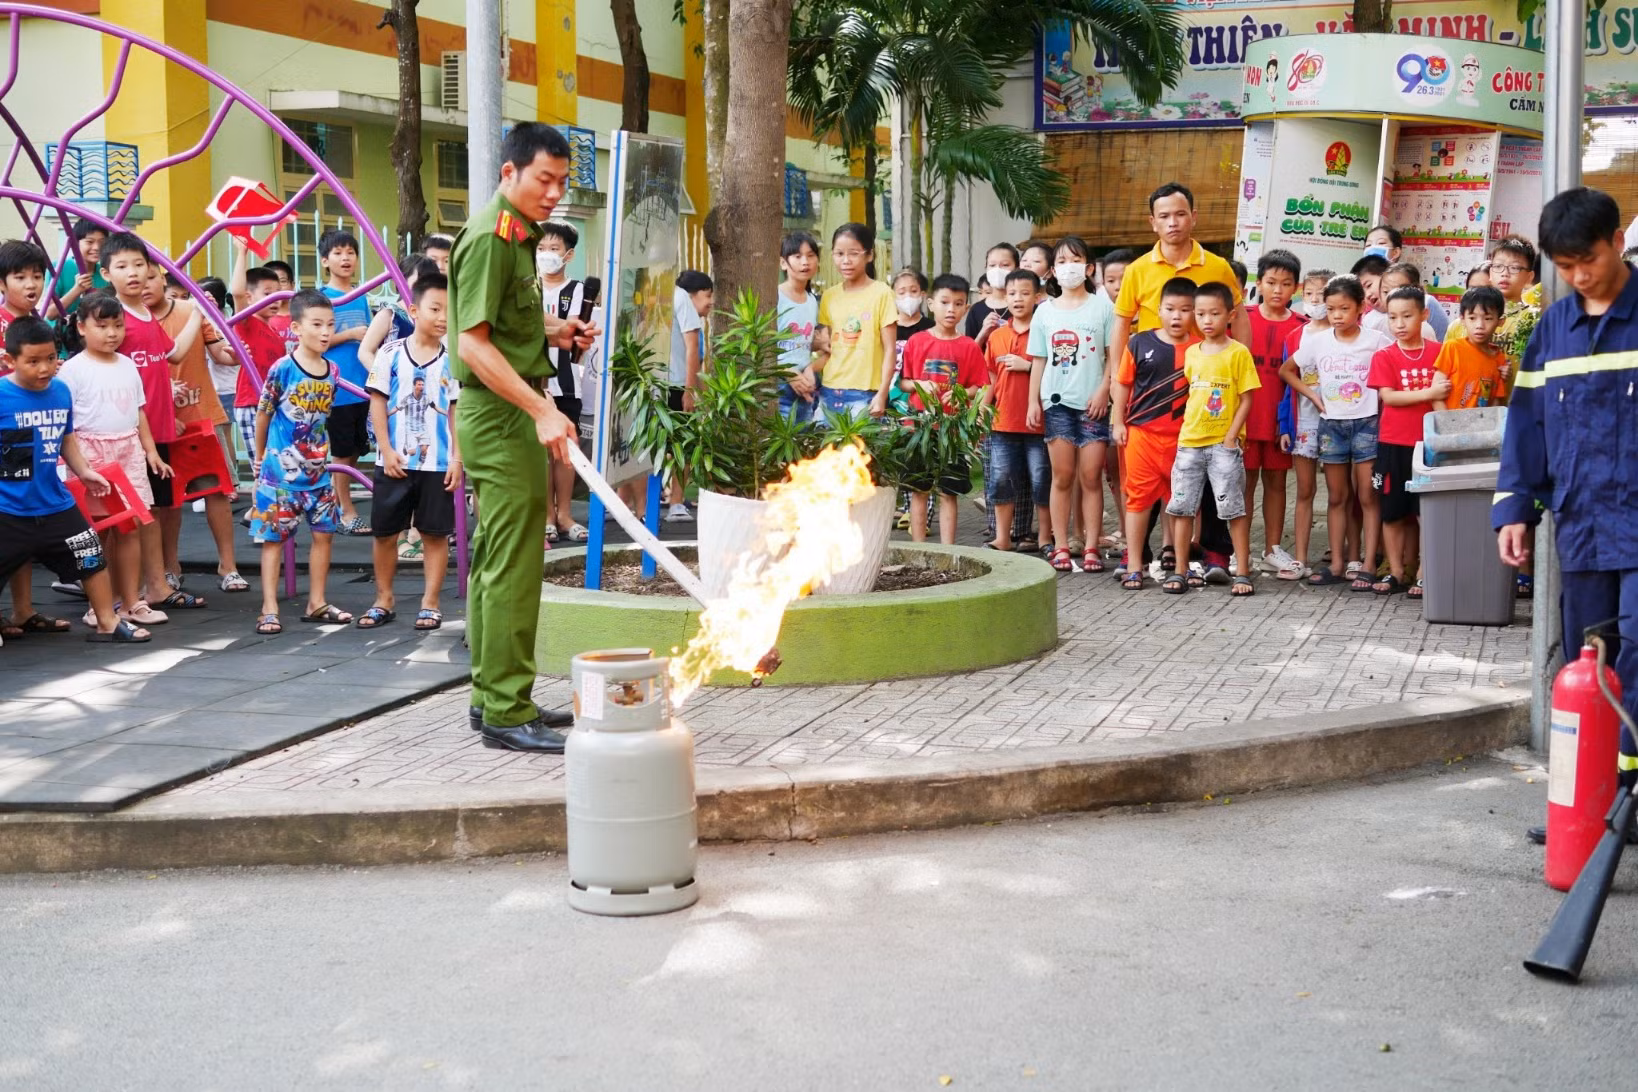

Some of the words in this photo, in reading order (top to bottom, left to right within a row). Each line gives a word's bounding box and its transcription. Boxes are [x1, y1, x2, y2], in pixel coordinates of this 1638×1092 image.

[1612, 8, 1638, 49] S
[1492, 66, 1533, 93] CÔNG
[1285, 194, 1324, 215] BỔN
[1330, 201, 1369, 222] PHẬN
[1281, 216, 1314, 234] CỦA
